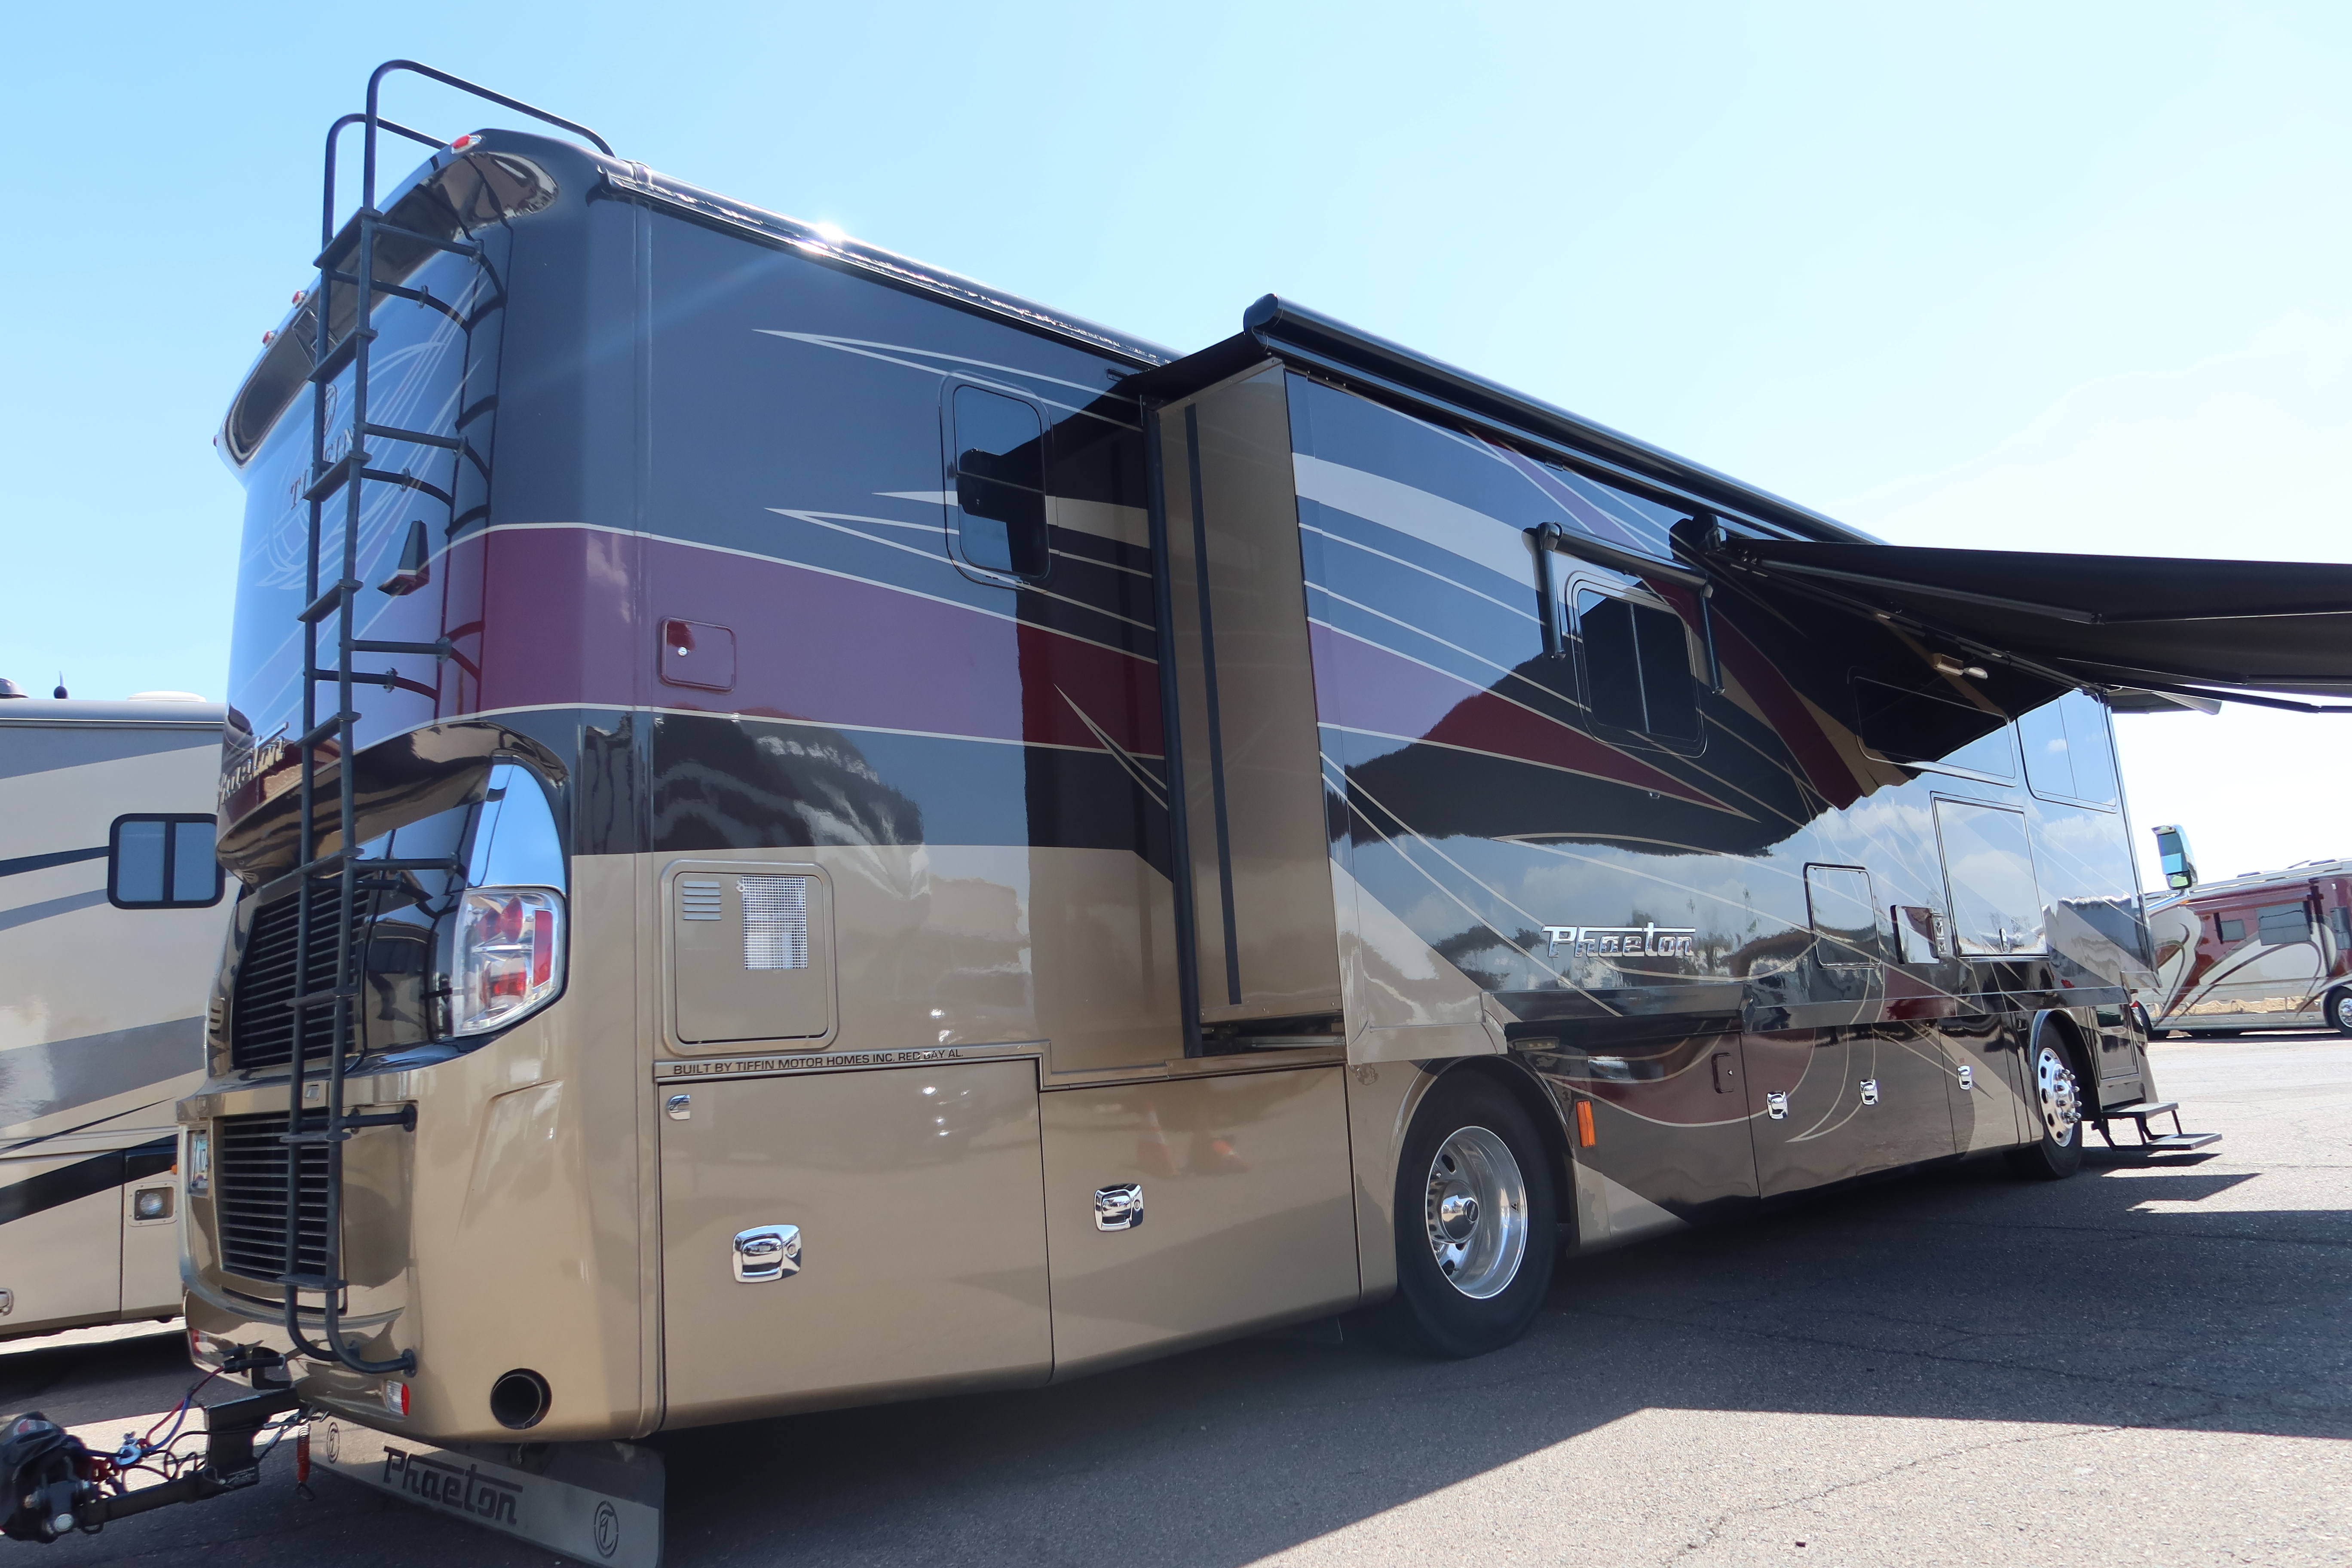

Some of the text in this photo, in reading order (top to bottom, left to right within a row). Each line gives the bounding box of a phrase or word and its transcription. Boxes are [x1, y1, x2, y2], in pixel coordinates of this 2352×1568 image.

[1541, 921, 1696, 957] Phaeton
[674, 1063, 711, 1075] BUILT
[715, 1062, 732, 1072] BY
[736, 1060, 774, 1071] TIFFIN
[778, 1057, 823, 1069] MOTOR
[827, 1054, 869, 1065] HOMES
[898, 1051, 920, 1061] RED
[383, 1446, 524, 1525] Phaeton
